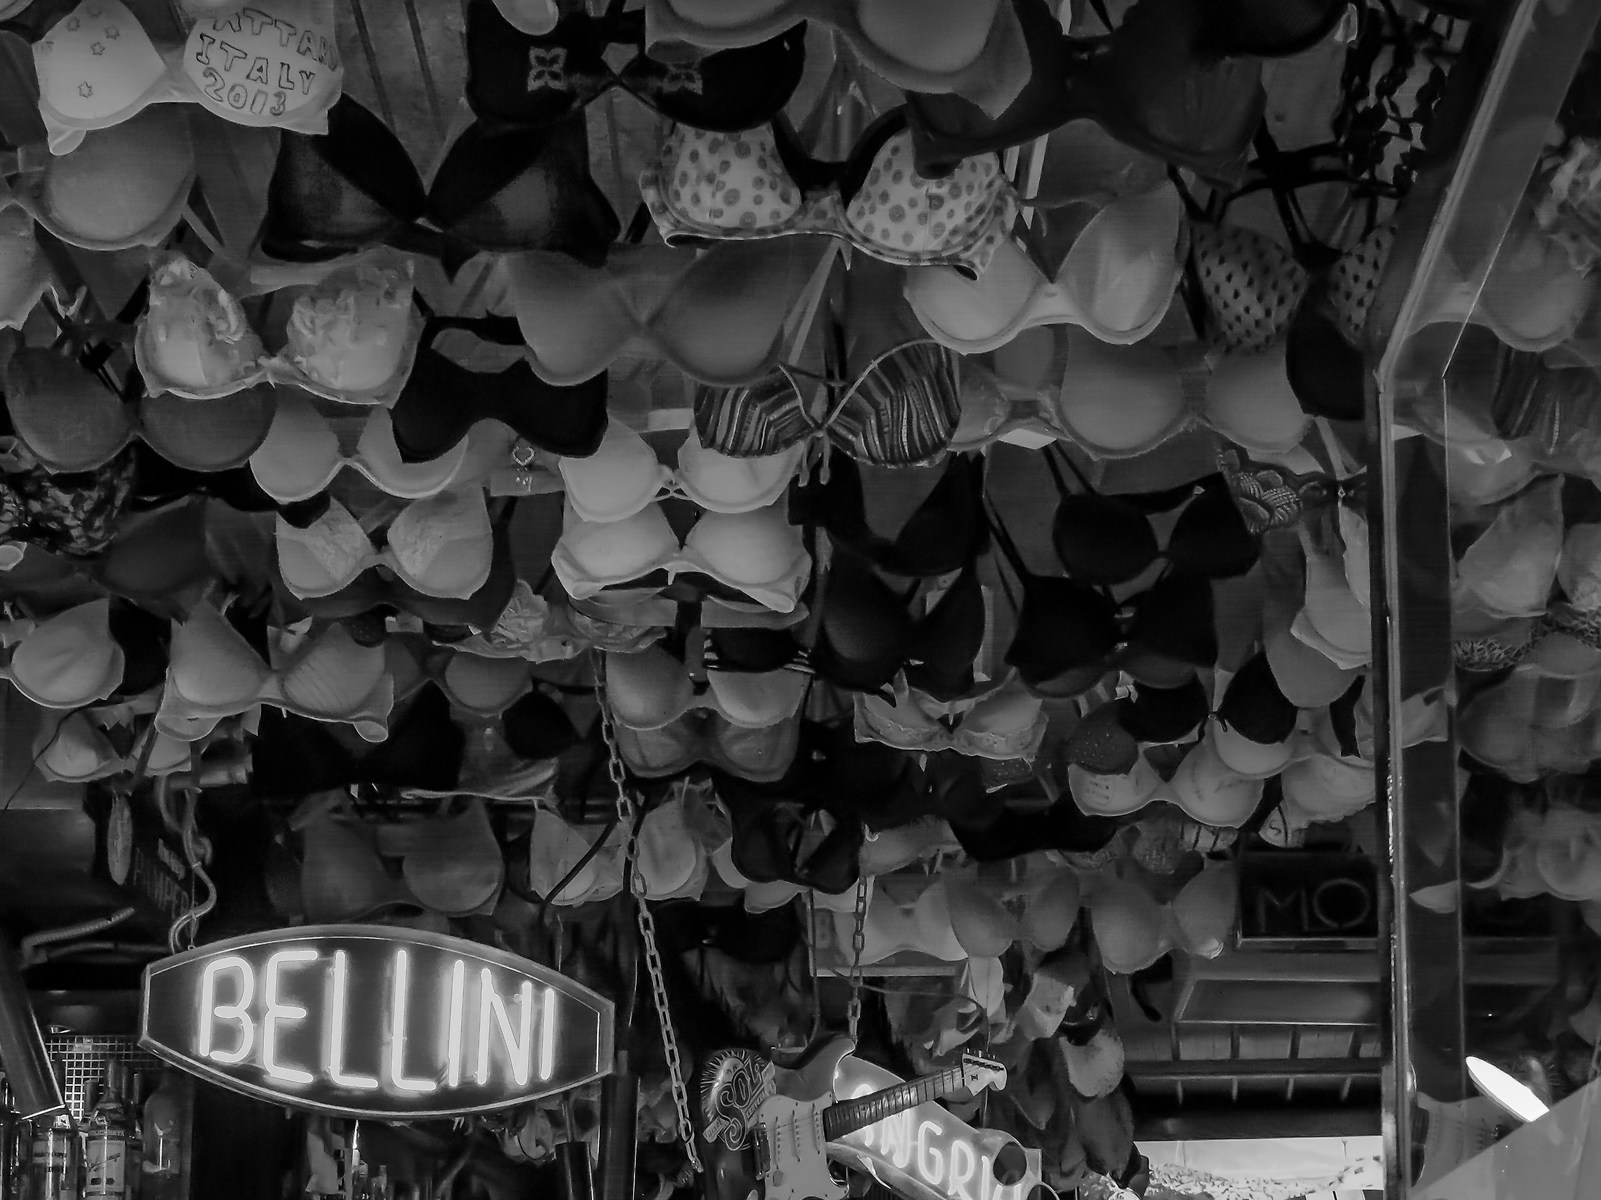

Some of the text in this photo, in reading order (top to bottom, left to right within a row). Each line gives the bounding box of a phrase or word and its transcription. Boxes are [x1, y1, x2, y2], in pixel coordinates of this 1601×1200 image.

[195, 32, 316, 96] ITALY
[202, 66, 287, 117] 2013
[199, 948, 556, 1091] BELLINI
